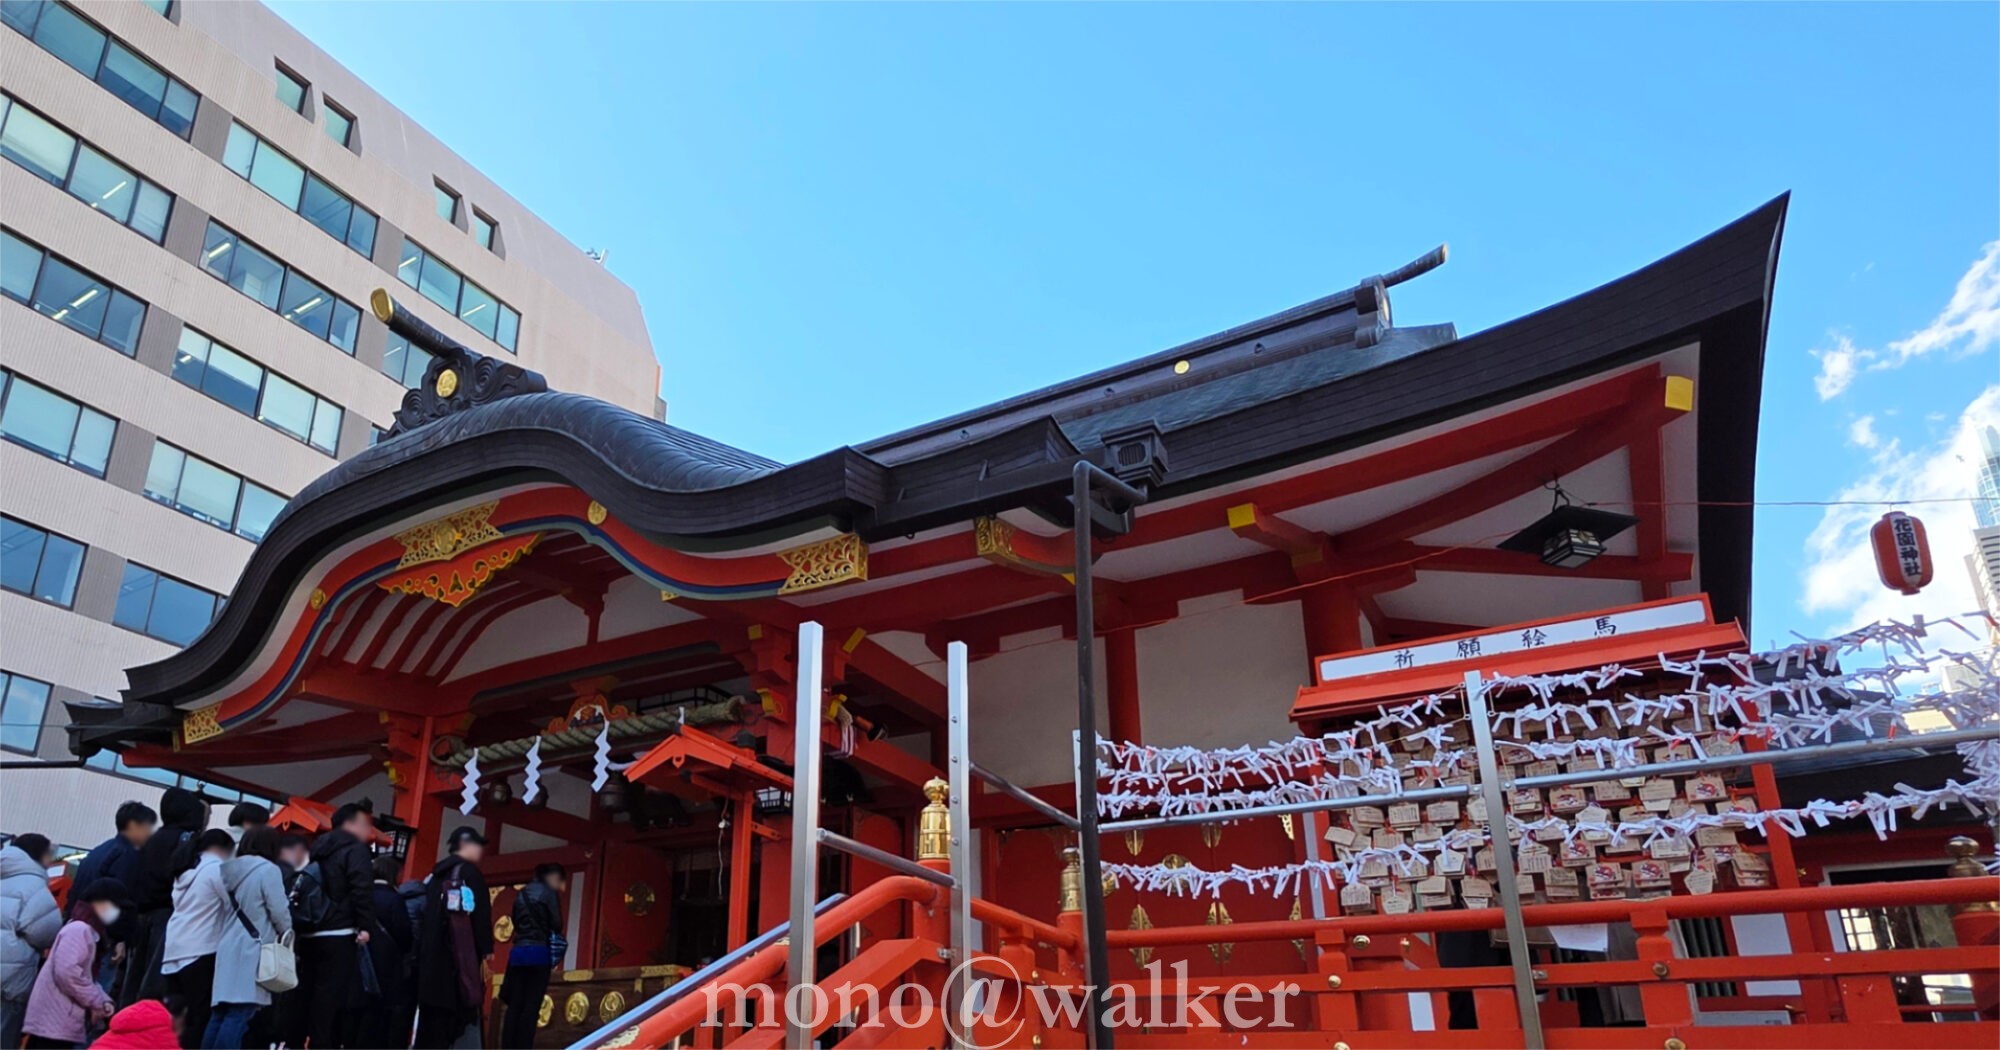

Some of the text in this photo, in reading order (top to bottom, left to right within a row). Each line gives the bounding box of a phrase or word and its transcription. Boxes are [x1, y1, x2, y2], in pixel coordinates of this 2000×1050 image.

[1893, 518, 1922, 576] 花園神社
[1394, 616, 1617, 668] 祈願絵馬
